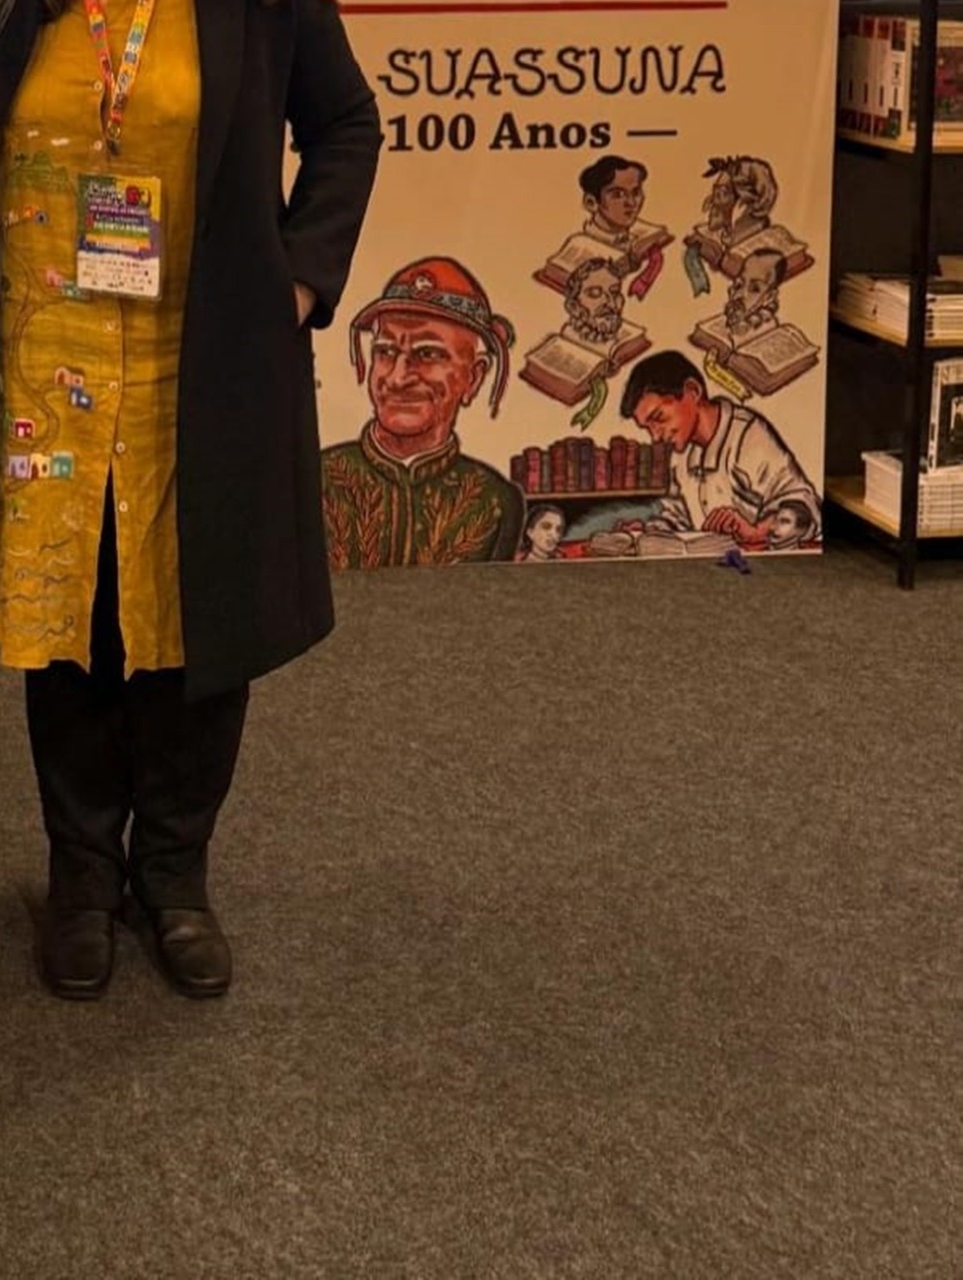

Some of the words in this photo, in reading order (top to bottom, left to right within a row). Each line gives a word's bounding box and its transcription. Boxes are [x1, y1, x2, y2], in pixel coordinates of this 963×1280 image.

[377, 43, 727, 100] SUASSUNA
[386, 113, 476, 152] 100
[489, 112, 612, 150] Anos
